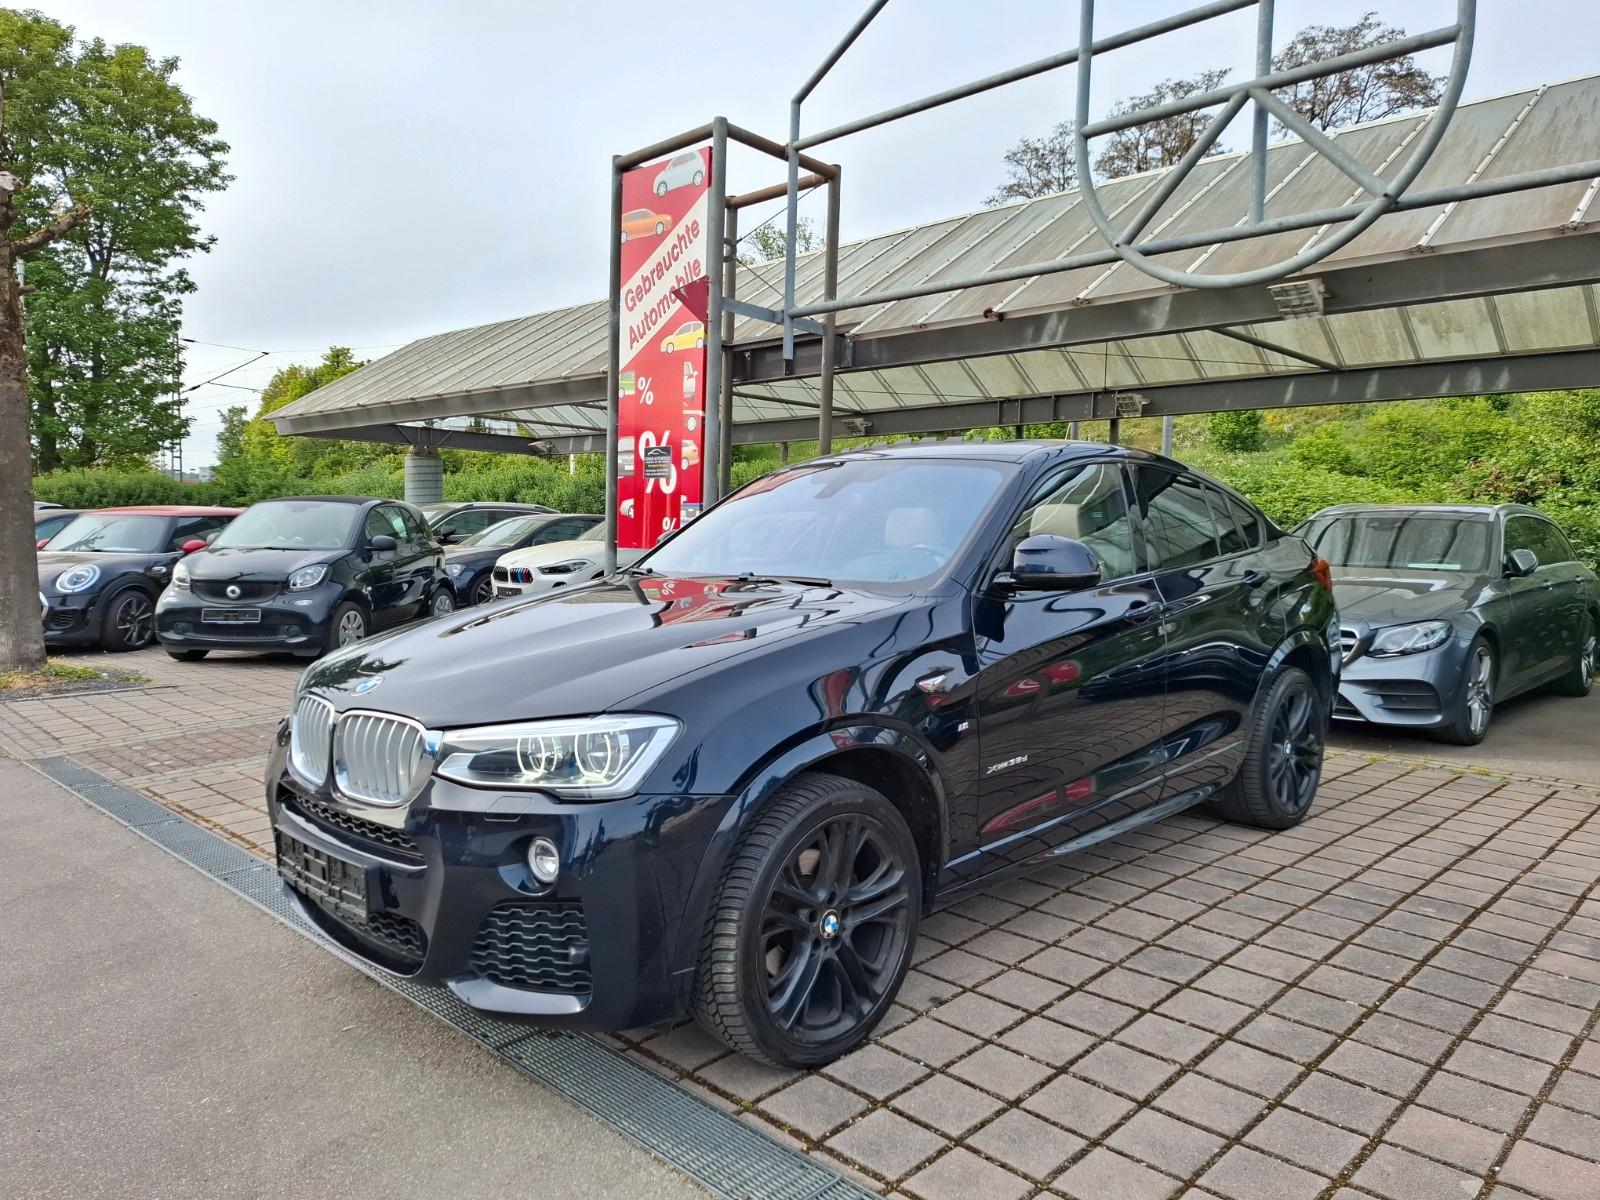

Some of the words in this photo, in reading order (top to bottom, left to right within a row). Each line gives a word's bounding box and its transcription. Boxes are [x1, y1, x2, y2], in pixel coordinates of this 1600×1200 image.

[624, 219, 700, 312] Gebrauchte
[628, 258, 702, 350] Automobile
[637, 377, 654, 405] %
